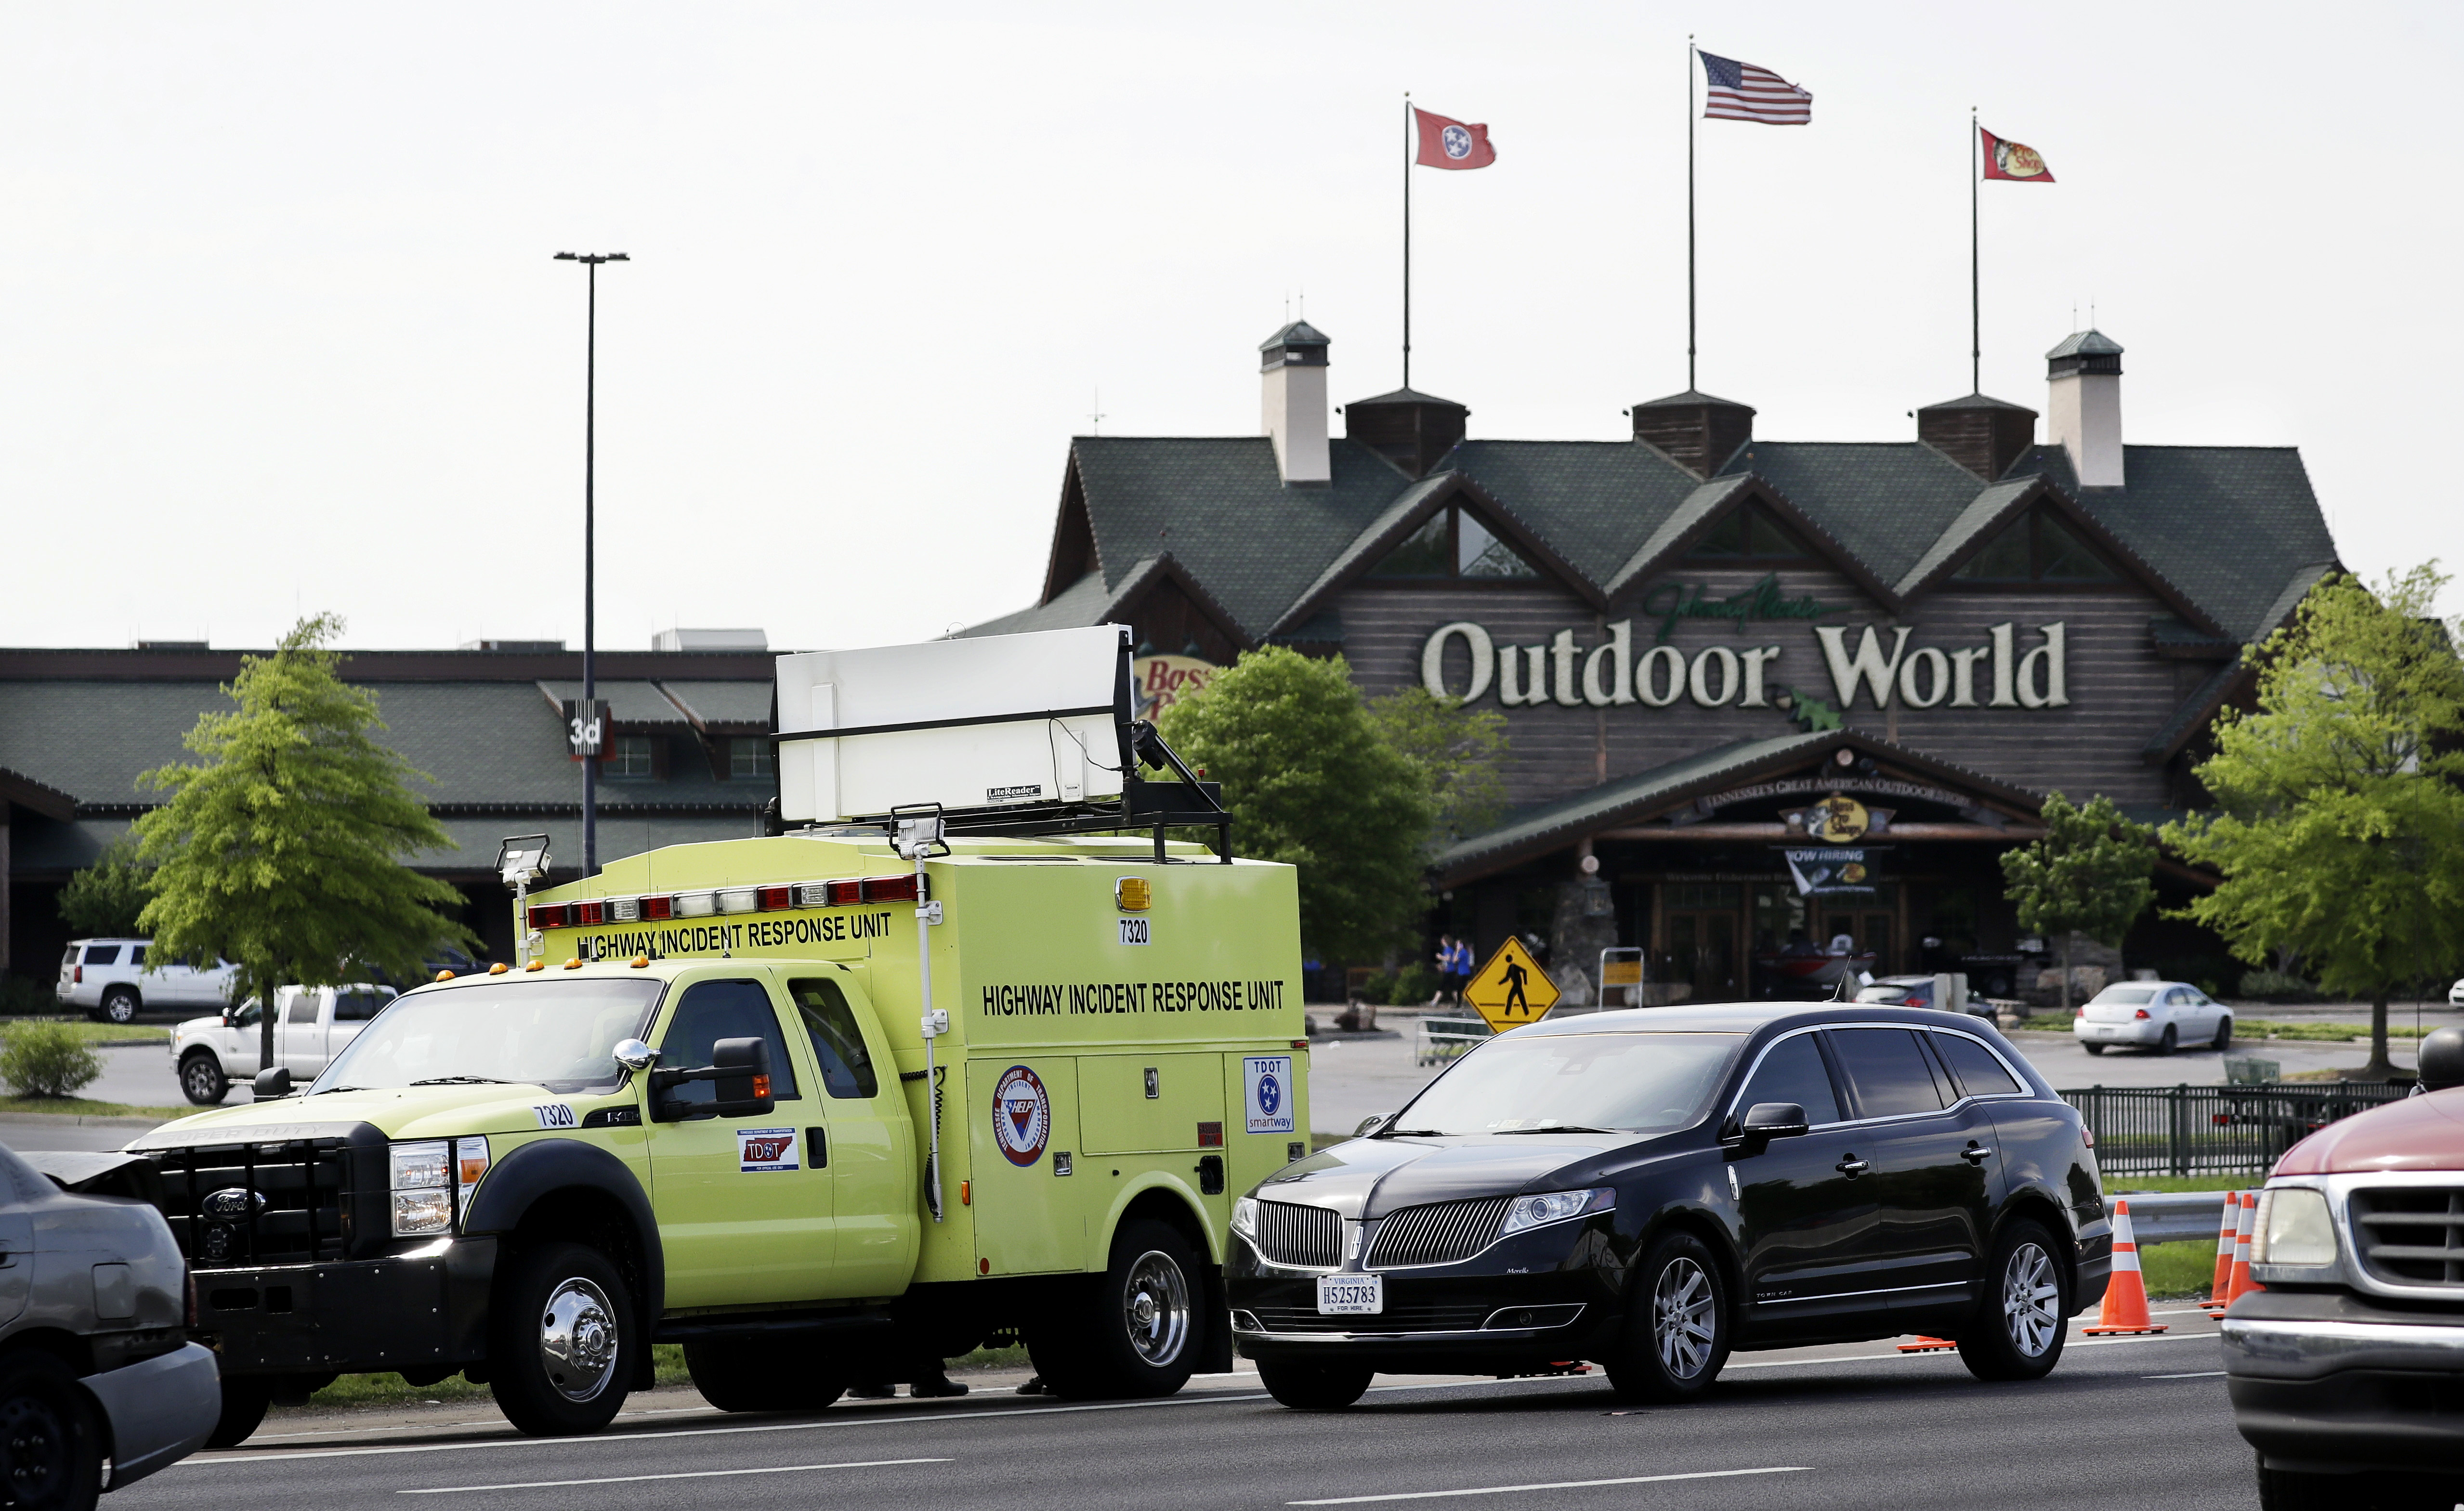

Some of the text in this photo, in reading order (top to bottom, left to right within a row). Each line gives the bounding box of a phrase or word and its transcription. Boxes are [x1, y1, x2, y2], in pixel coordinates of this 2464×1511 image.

[1420, 619, 2071, 709] Outdoor World
[570, 717, 601, 745] 3d
[988, 786, 1035, 796] LiteReader
[1814, 777, 1874, 792] AMERICAN
[1819, 849, 1864, 862] HIRING
[577, 912, 891, 960] HIGHWAY INCIDENT RESPONSE UNIT
[1120, 919, 1148, 944] 7320
[983, 980, 1284, 1016] HIGHWAY INCIDENT RESPONSE UNIT
[1254, 1061, 1281, 1073] TDOT
[1008, 1081, 1031, 1092] INCIDENT
[532, 1104, 573, 1126] 7320
[994, 1069, 1048, 1151] TENNESSEE DEPARTMENT OF TRANSPORTATION
[1011, 1101, 1034, 1113] HELP
[1249, 1117, 1291, 1129] smartway
[162, 1124, 325, 1143] SUPER DUTY
[747, 1143, 780, 1159] TDOT
[215, 1194, 248, 1212] Ford
[1324, 1286, 1376, 1304] H525783
